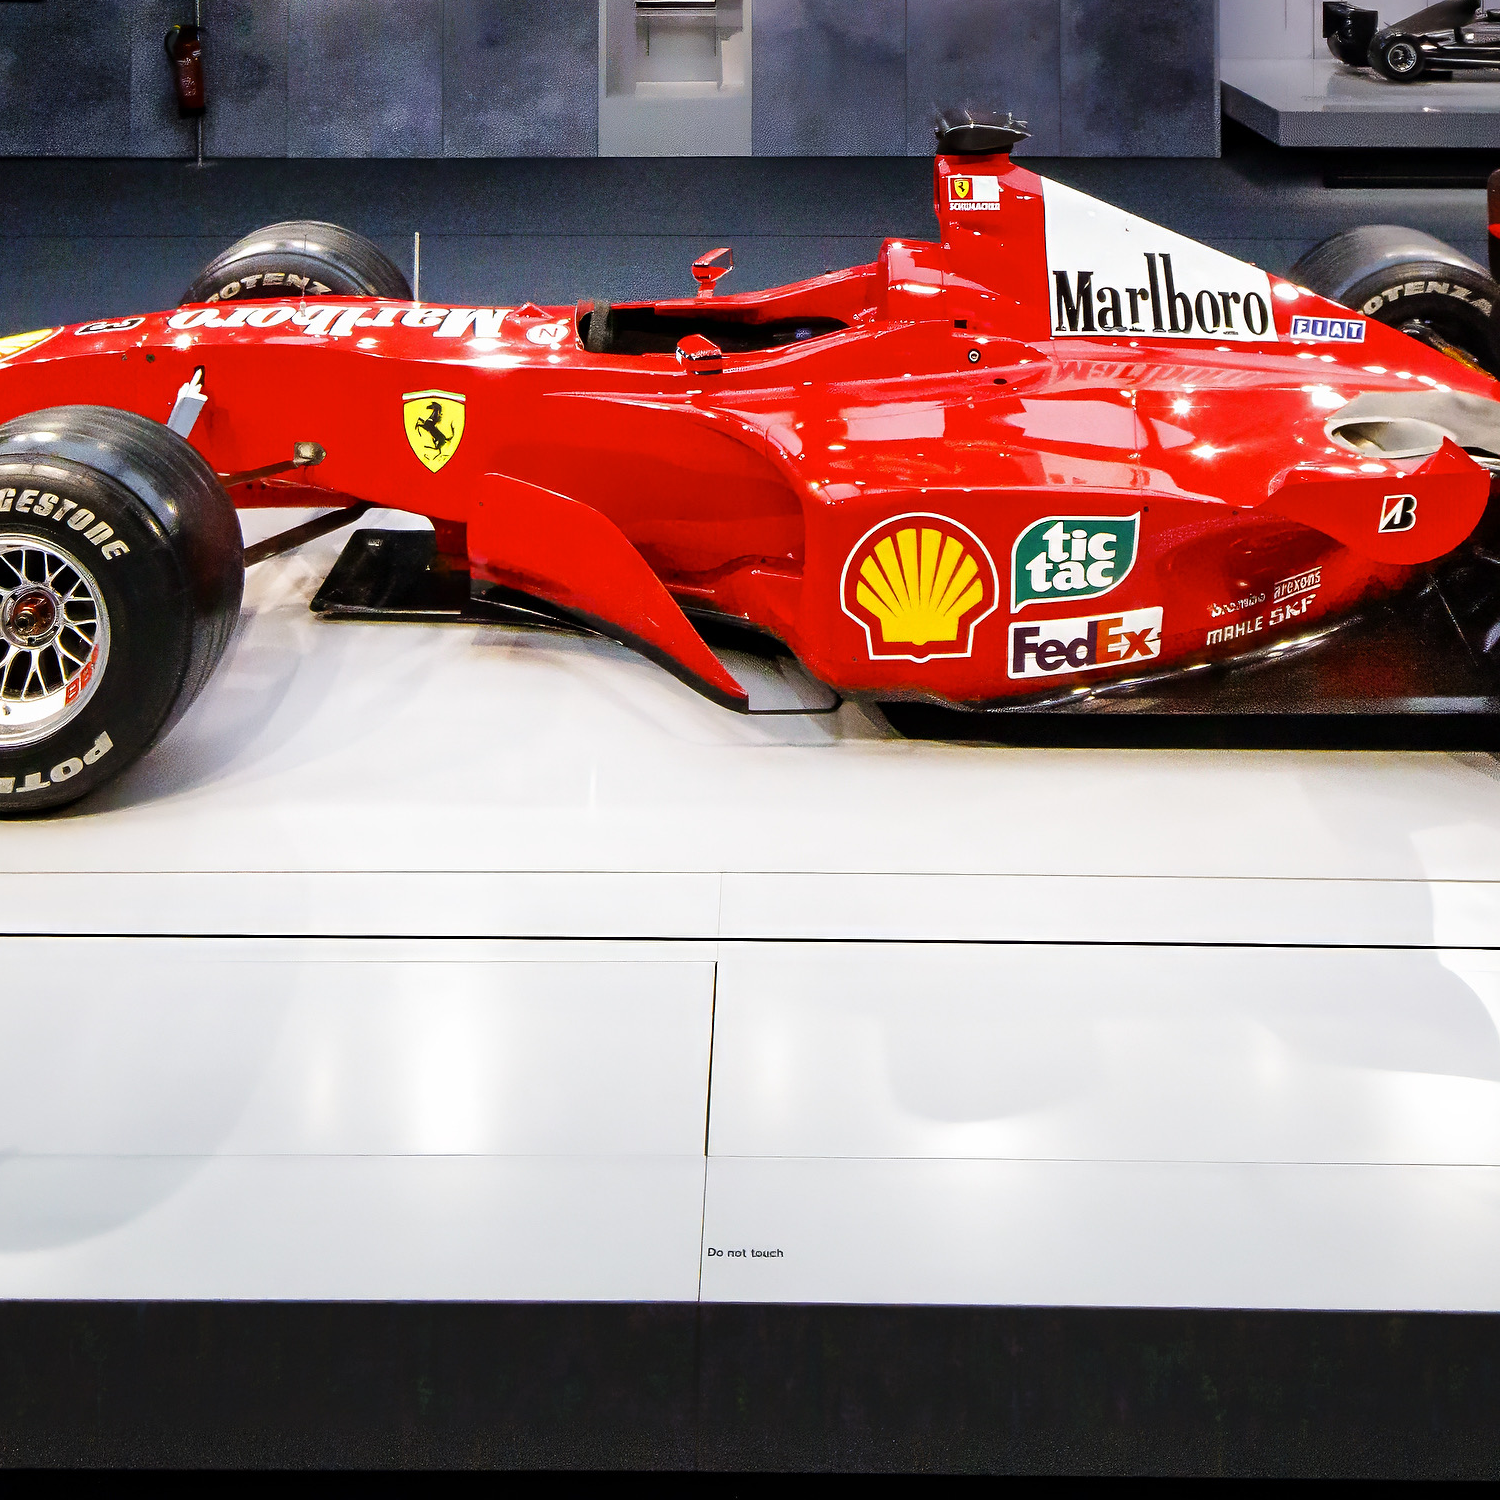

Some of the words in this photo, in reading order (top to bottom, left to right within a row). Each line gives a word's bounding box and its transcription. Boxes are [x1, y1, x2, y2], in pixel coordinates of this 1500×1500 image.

[1052, 252, 1269, 336] Marlboro
[1356, 281, 1493, 318] OTENZA
[168, 304, 514, 338] Marlboro
[1294, 319, 1363, 339] FIAT
[1042, 521, 1118, 563] tic
[1025, 552, 1116, 593] tac
[1273, 570, 1321, 600] arexons
[1268, 593, 1317, 626] SKF
[1012, 617, 1155, 674] FedEx
[1206, 615, 1264, 646] MAHLE
[707, 1247, 723, 1258] Do
[727, 1248, 747, 1258] not
[750, 1248, 784, 1258] touch
